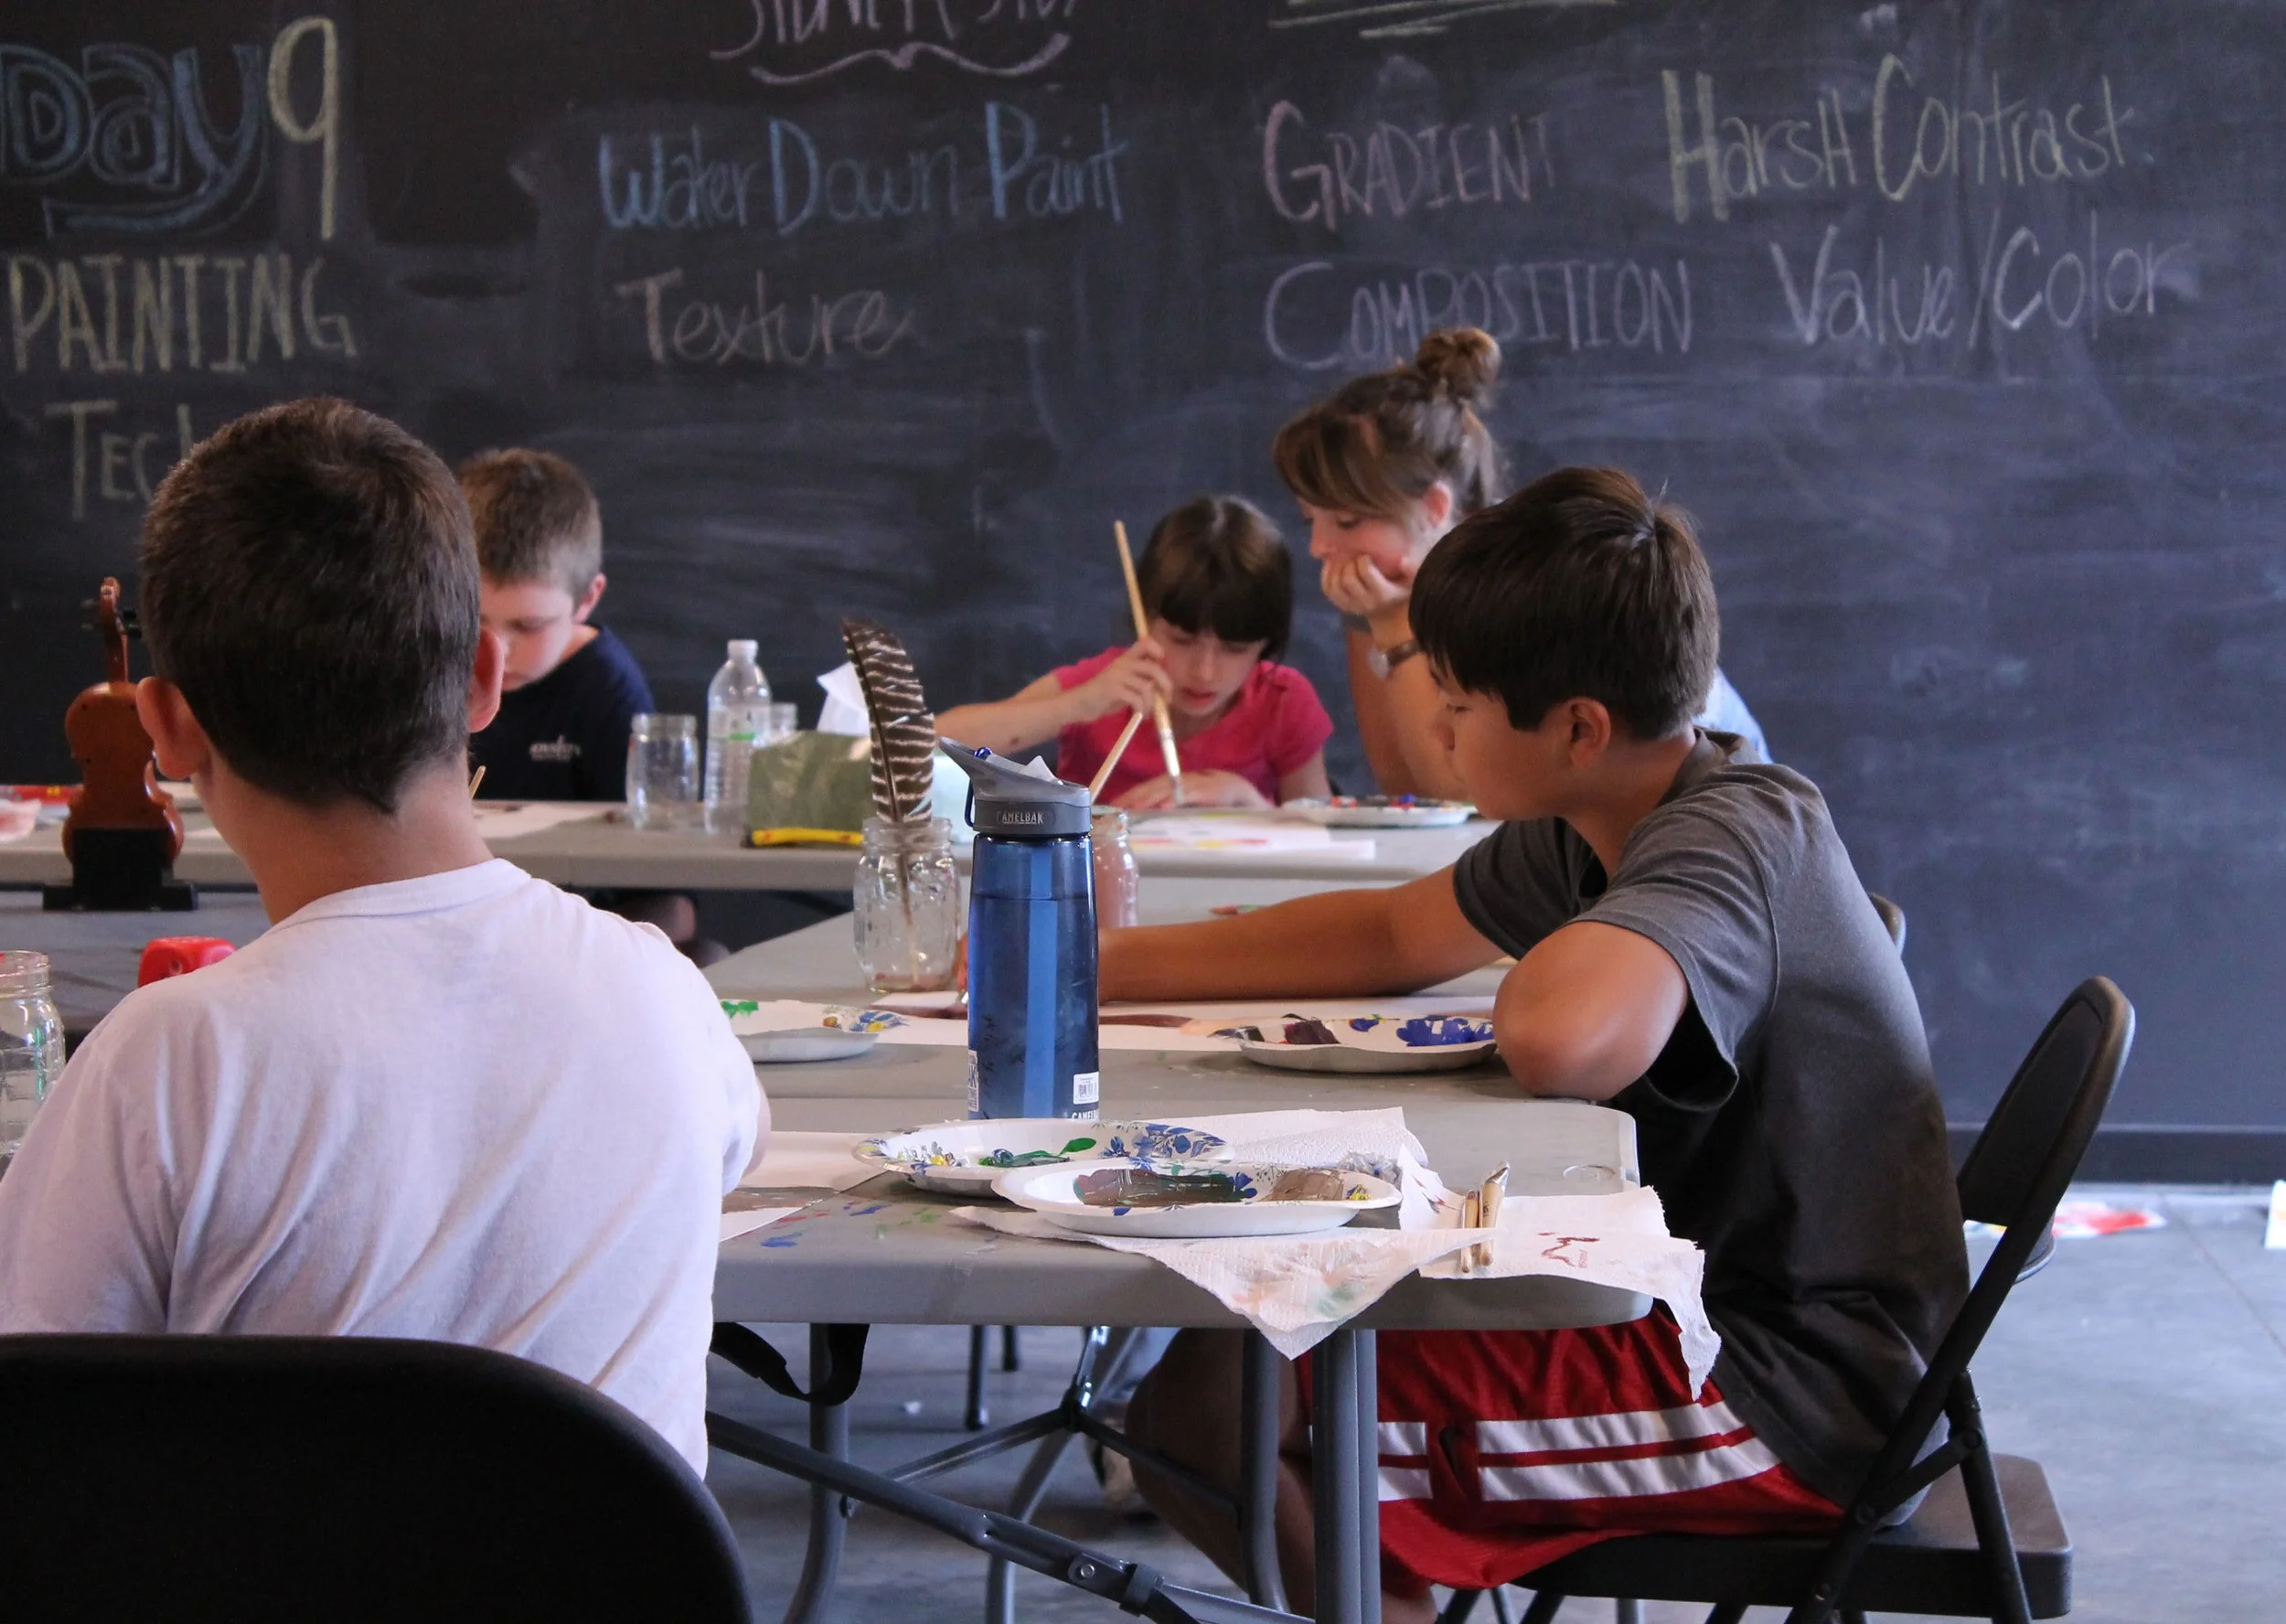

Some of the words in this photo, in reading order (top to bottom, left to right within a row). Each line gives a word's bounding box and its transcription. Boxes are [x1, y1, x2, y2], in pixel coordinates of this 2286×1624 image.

[0, 43, 268, 239] Day
[268, 16, 338, 240] 9
[599, 125, 760, 230] Water
[768, 115, 958, 237] Down
[985, 102, 1128, 221] Paint
[1872, 54, 2135, 201] Contrast
[10, 253, 358, 373] PAINTING
[614, 268, 913, 365] Texture
